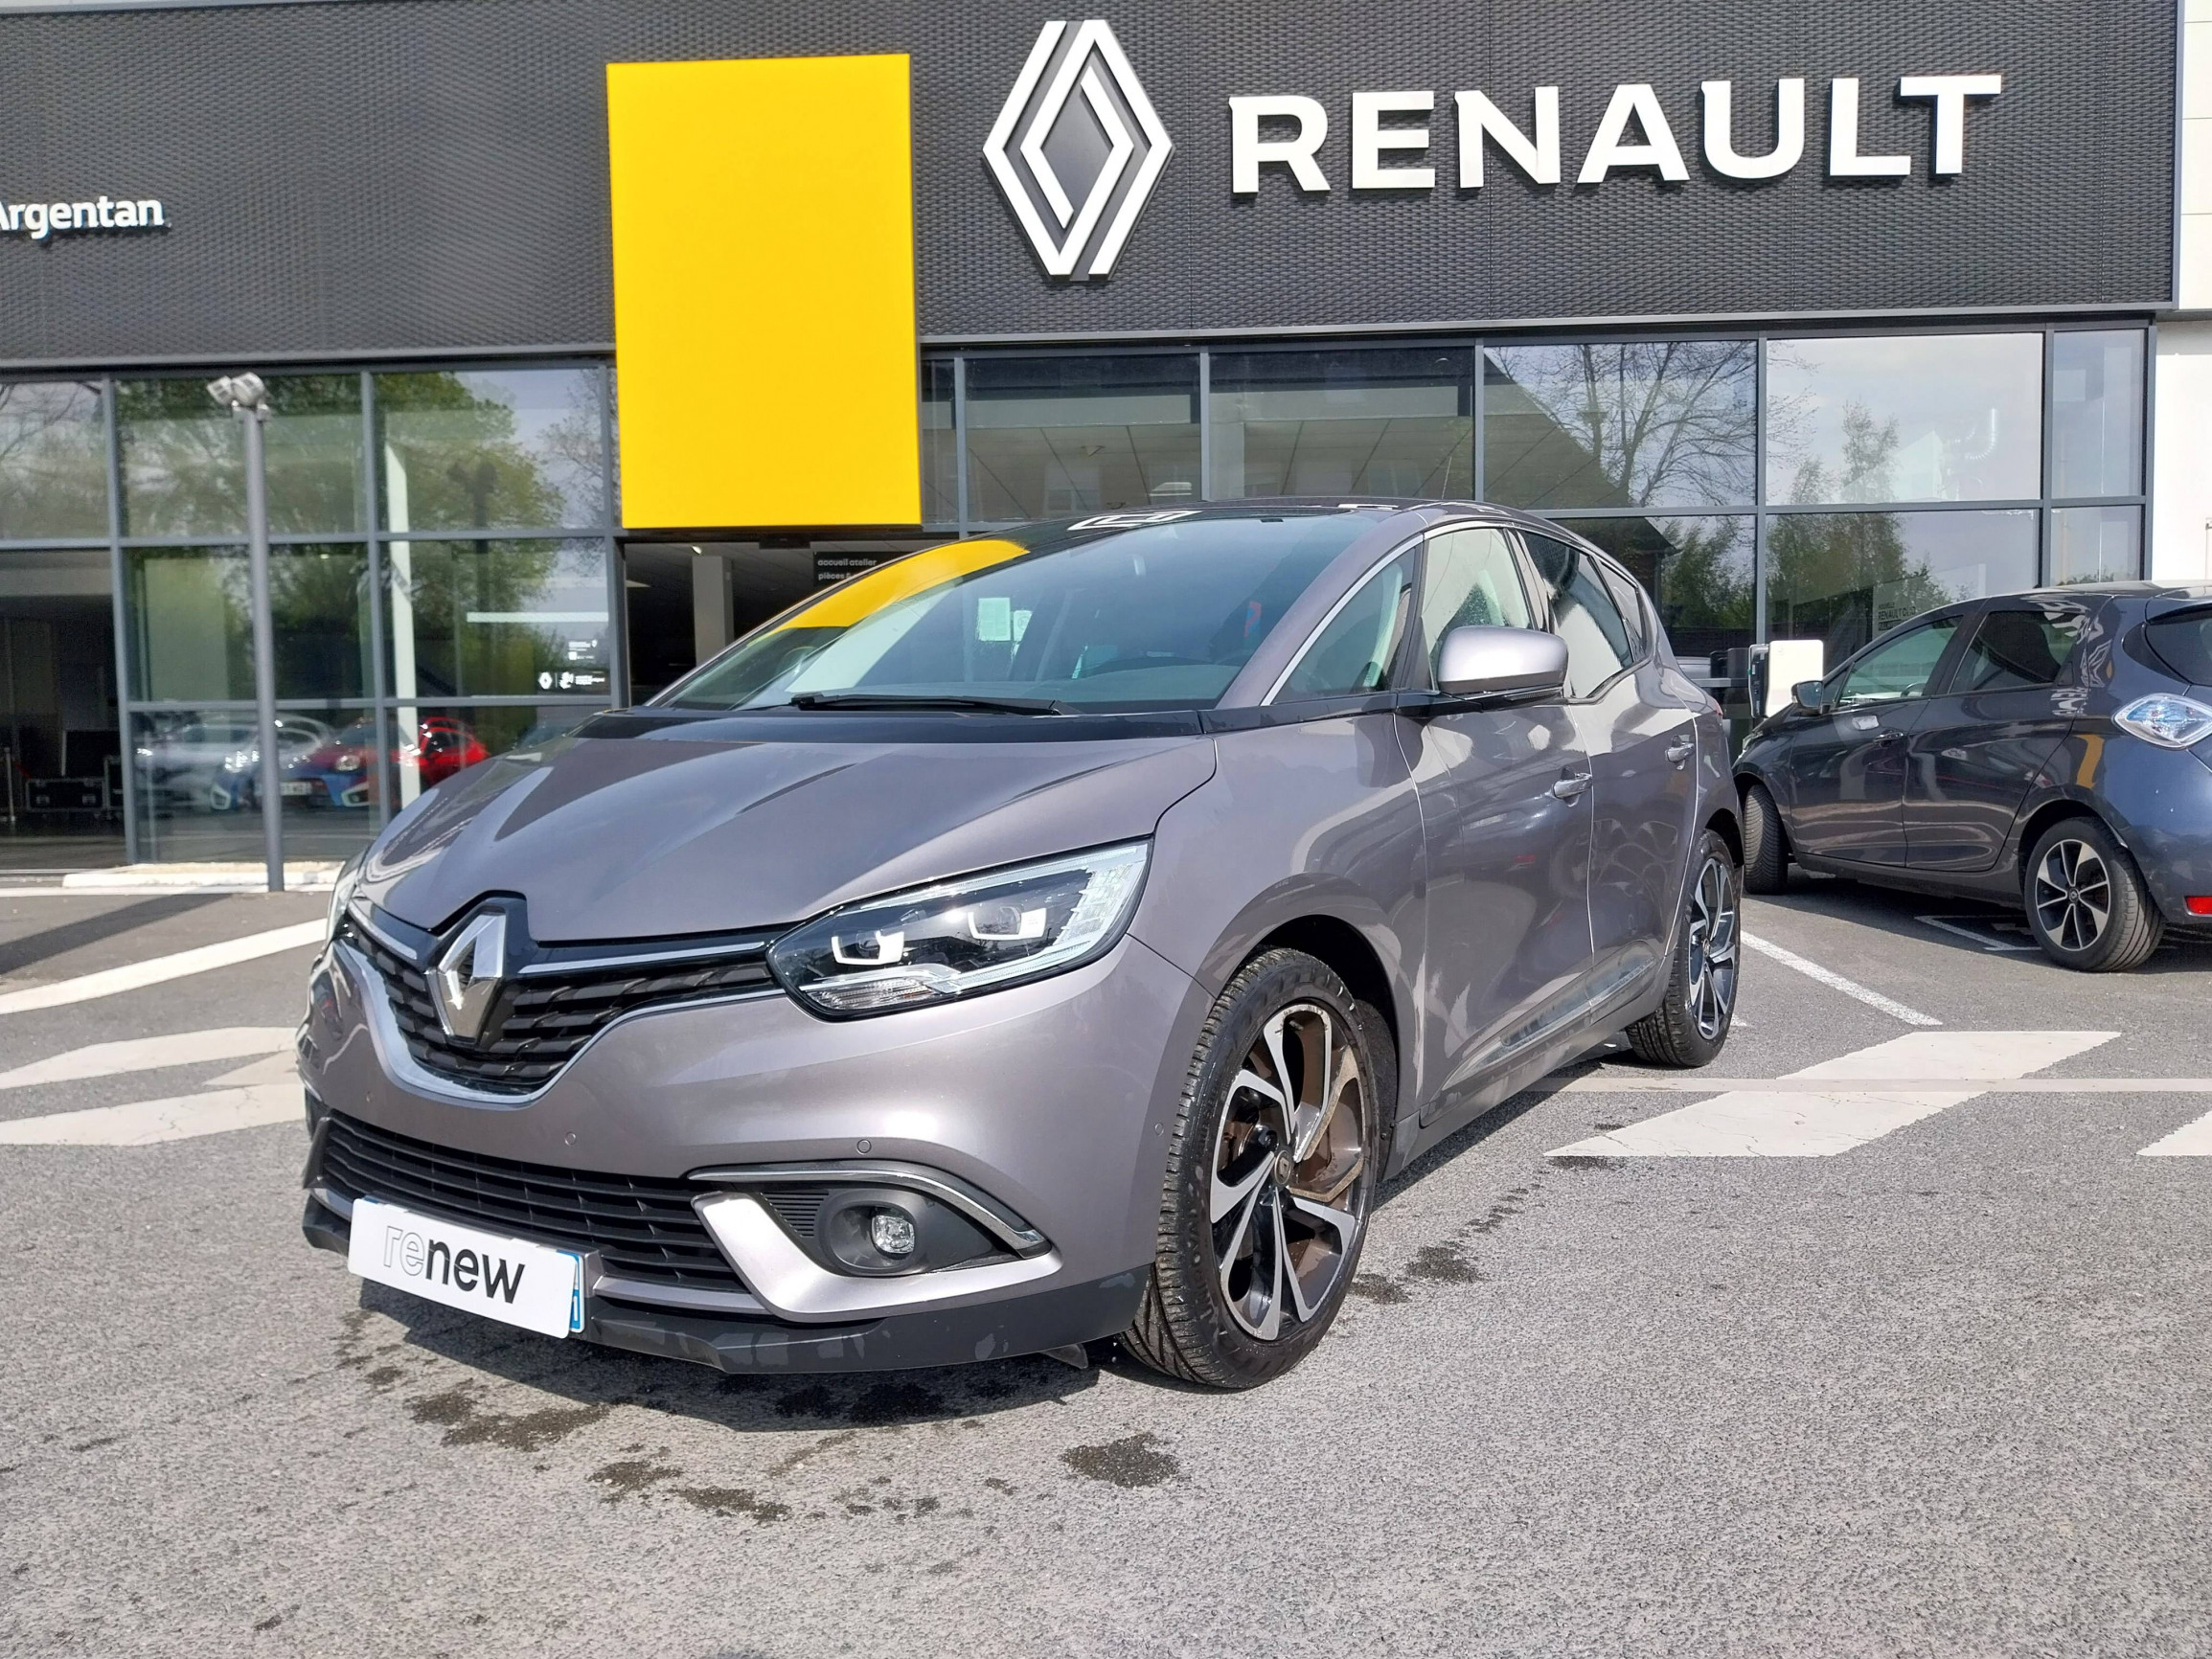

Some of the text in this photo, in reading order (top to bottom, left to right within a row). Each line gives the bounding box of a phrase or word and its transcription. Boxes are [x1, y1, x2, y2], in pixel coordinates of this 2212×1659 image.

[1228, 73, 2004, 194] RENAULT
[818, 572, 845, 581] pièces
[383, 1225, 526, 1305] renew
